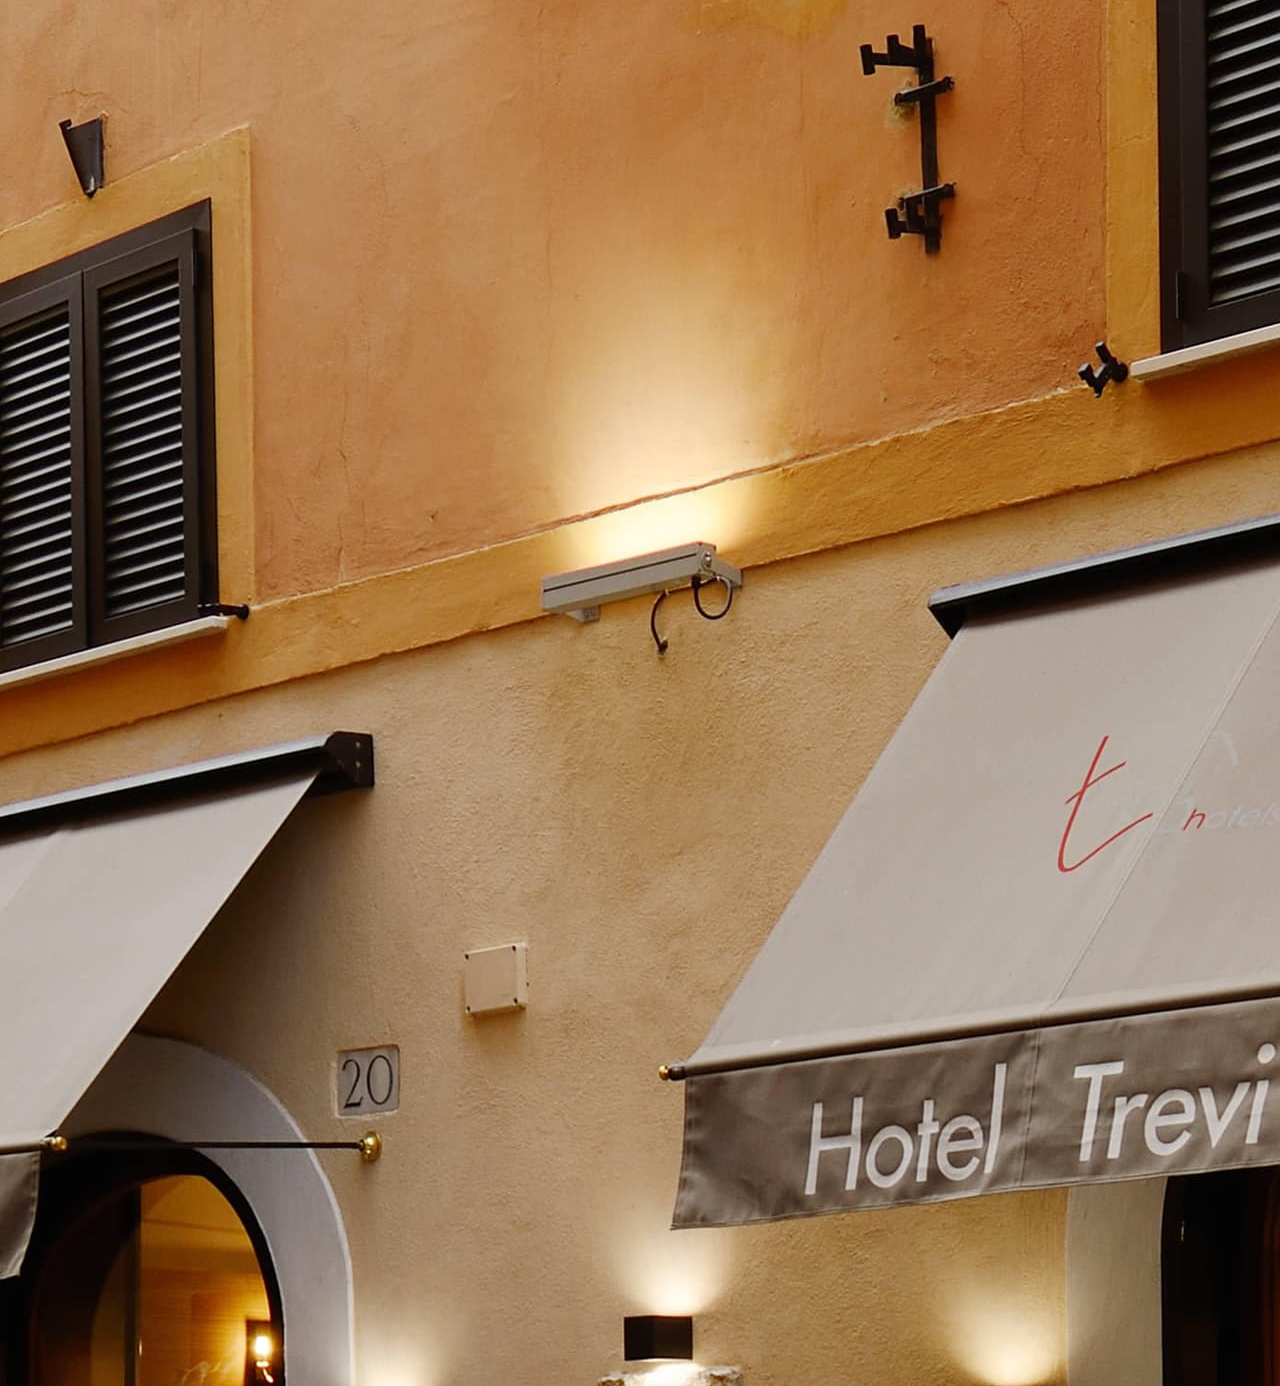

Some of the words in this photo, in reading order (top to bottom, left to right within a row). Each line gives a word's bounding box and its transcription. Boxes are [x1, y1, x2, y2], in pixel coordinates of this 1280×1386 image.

[341, 1054, 394, 1110] 20
[804, 1063, 1007, 1196] Hotel
[1073, 1043, 1276, 1162] Trevi
